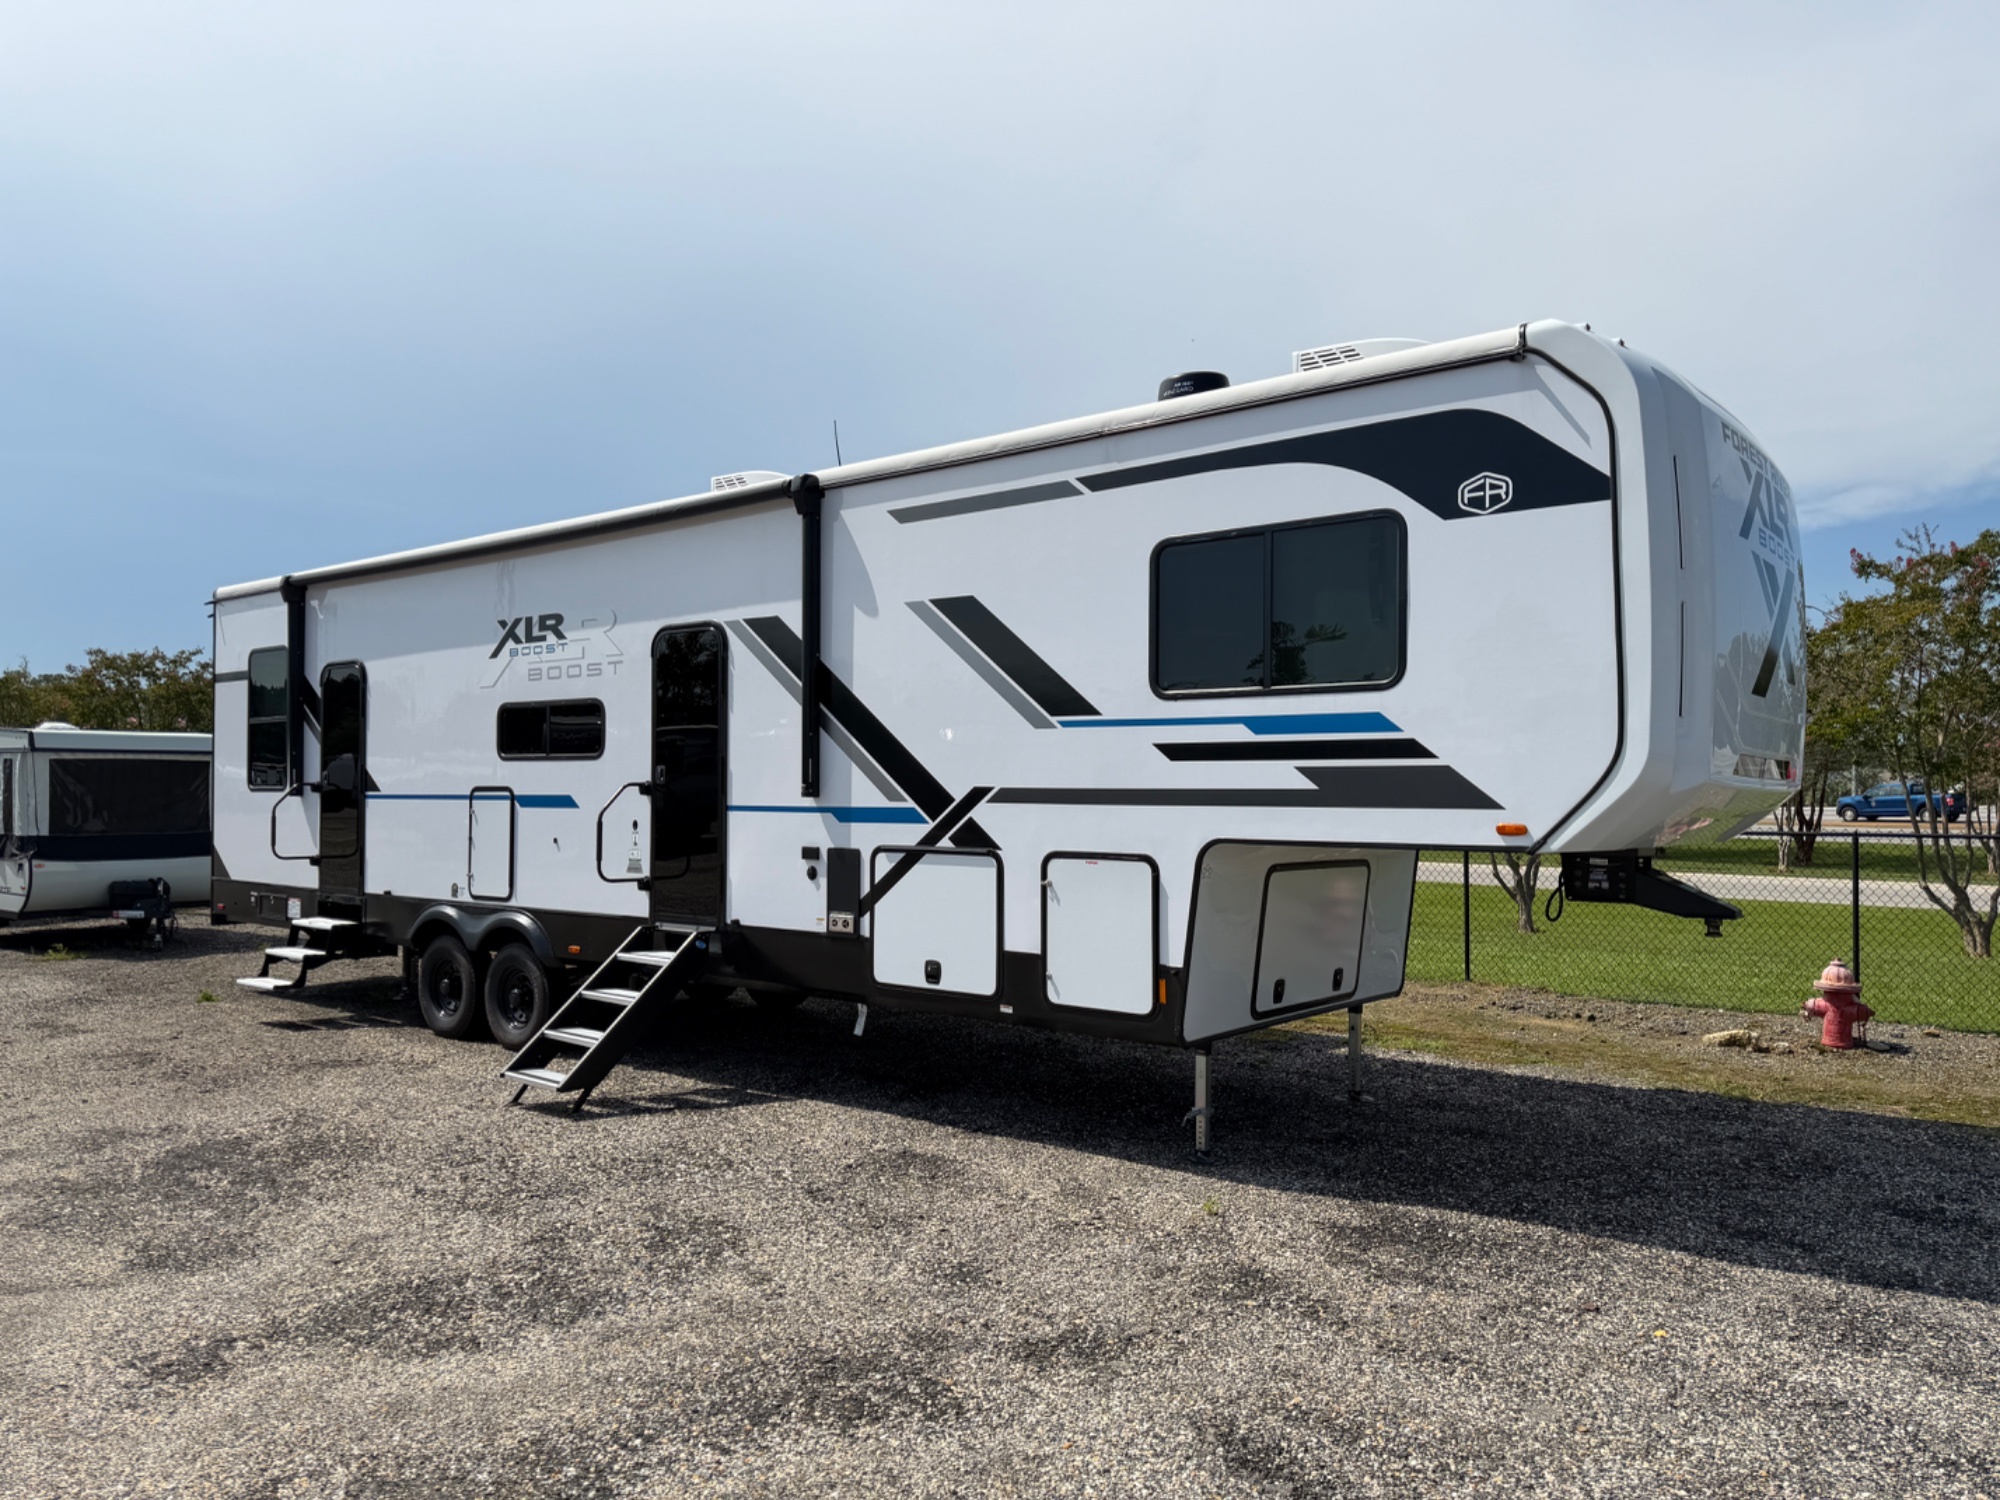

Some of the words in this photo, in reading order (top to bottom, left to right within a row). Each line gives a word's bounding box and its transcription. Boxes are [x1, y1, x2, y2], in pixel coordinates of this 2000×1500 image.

[1721, 421, 1770, 477] FOREST
[1739, 456, 1794, 557] XLR
[1758, 527, 1795, 574] BOOST
[489, 612, 568, 660] XLR
[509, 642, 568, 657] BOOST
[527, 660, 624, 682] BOOST
